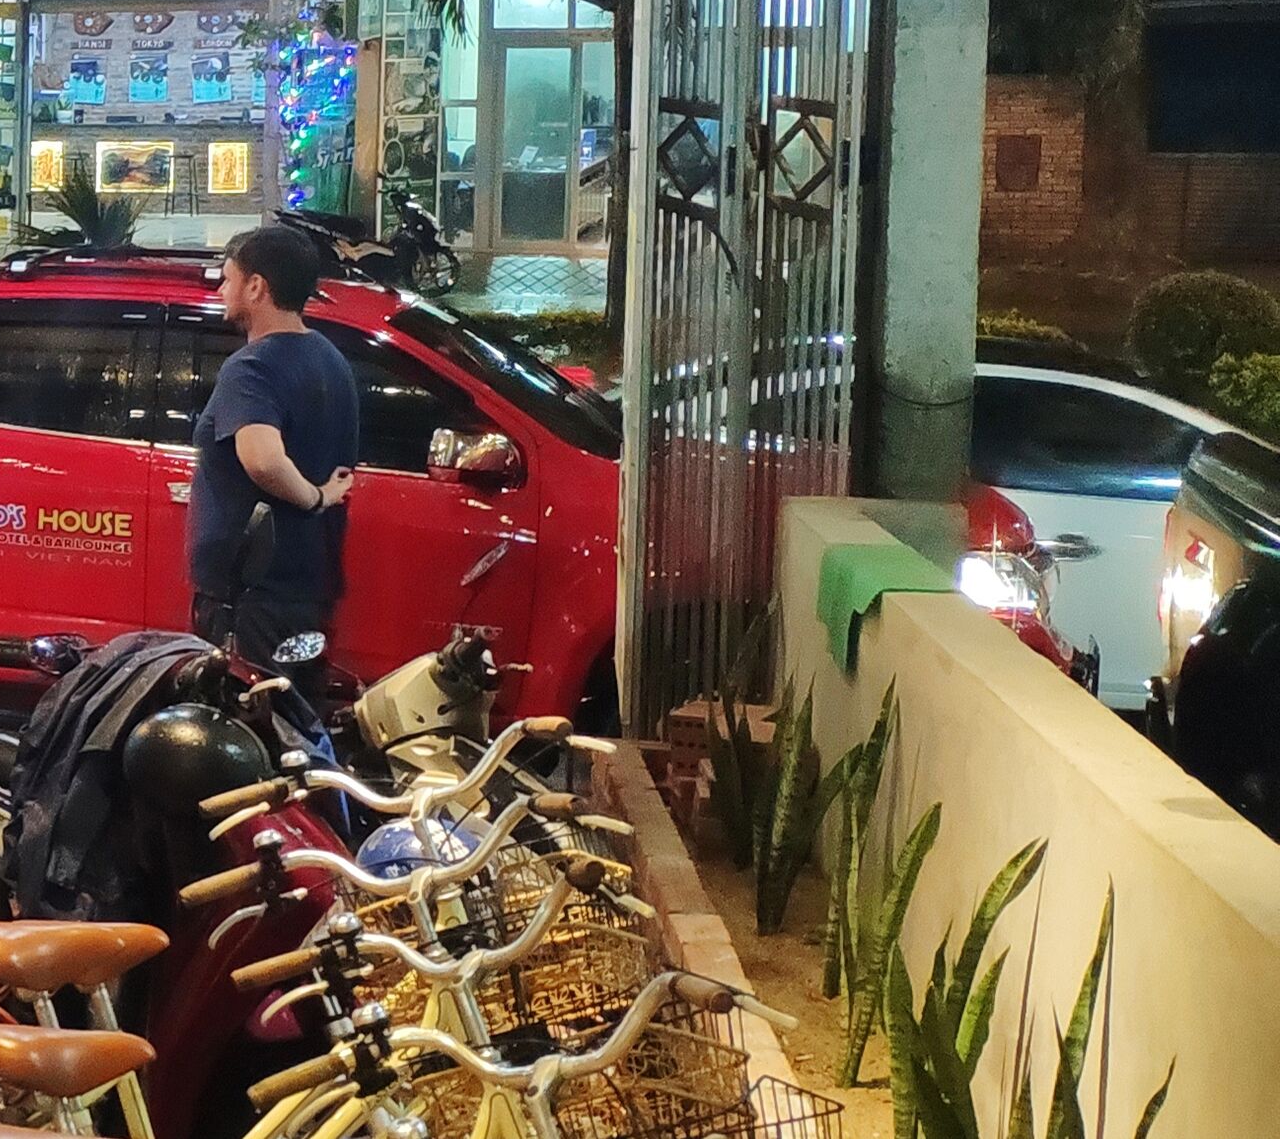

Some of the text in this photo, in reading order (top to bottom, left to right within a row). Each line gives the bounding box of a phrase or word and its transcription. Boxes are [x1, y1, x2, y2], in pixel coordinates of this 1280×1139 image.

[37, 507, 133, 537] HOUSE
[32, 535, 43, 546] &
[74, 539, 132, 554] LOUNGE
